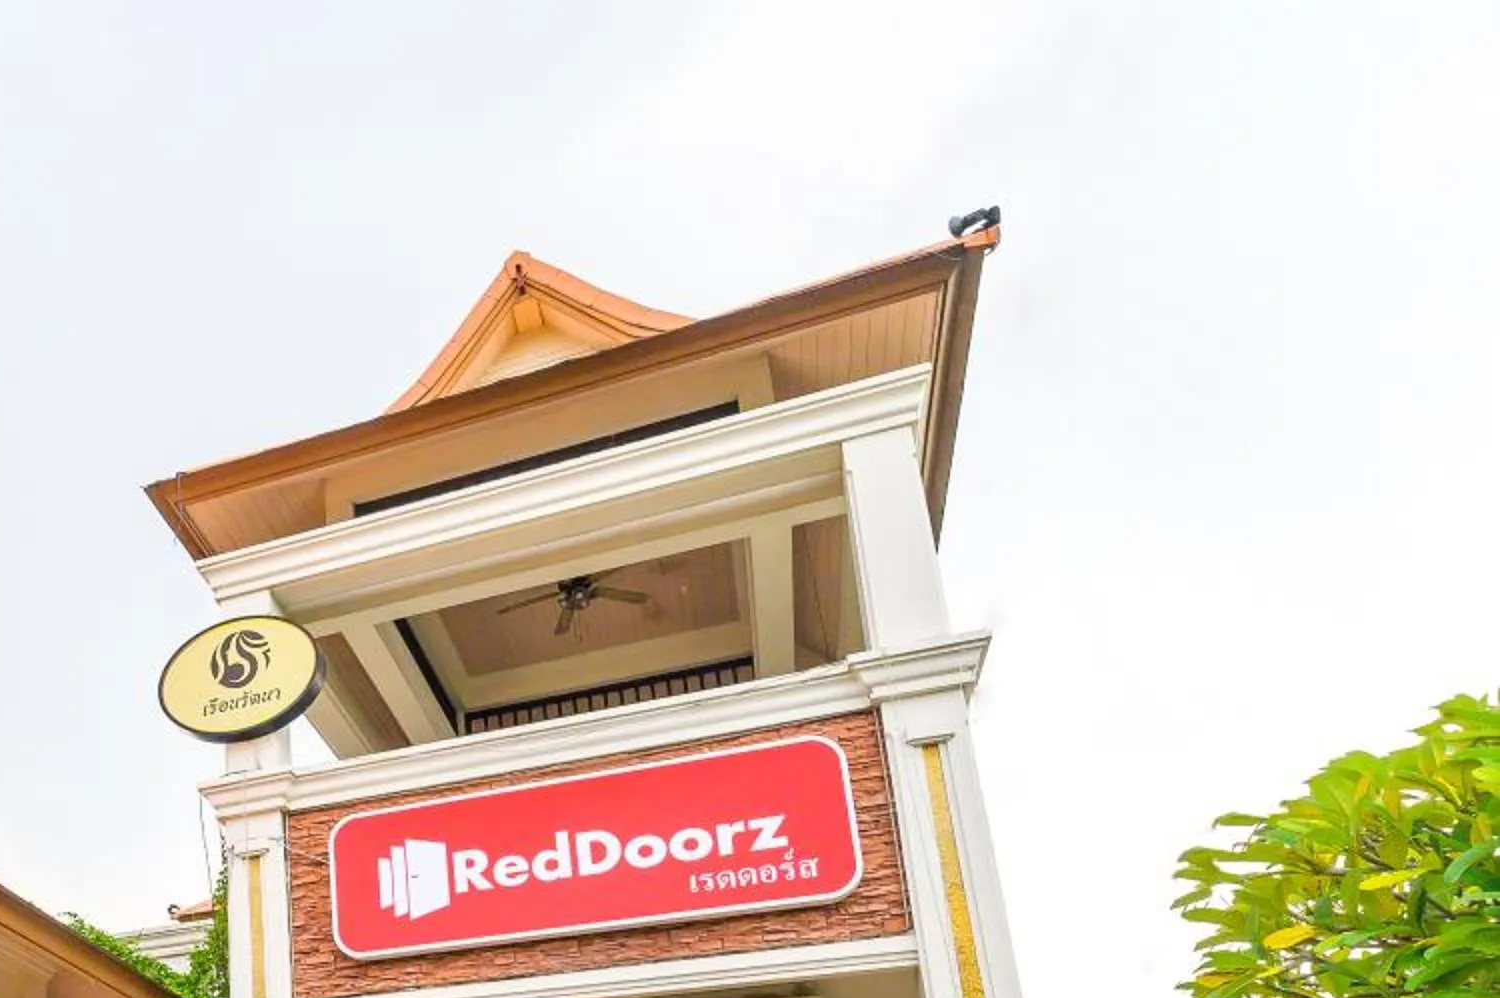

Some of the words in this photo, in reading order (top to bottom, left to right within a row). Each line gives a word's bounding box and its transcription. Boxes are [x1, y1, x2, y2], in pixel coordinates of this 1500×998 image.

[452, 813, 789, 894] RedDoorz
[689, 847, 820, 893] เรดดอร์ส
